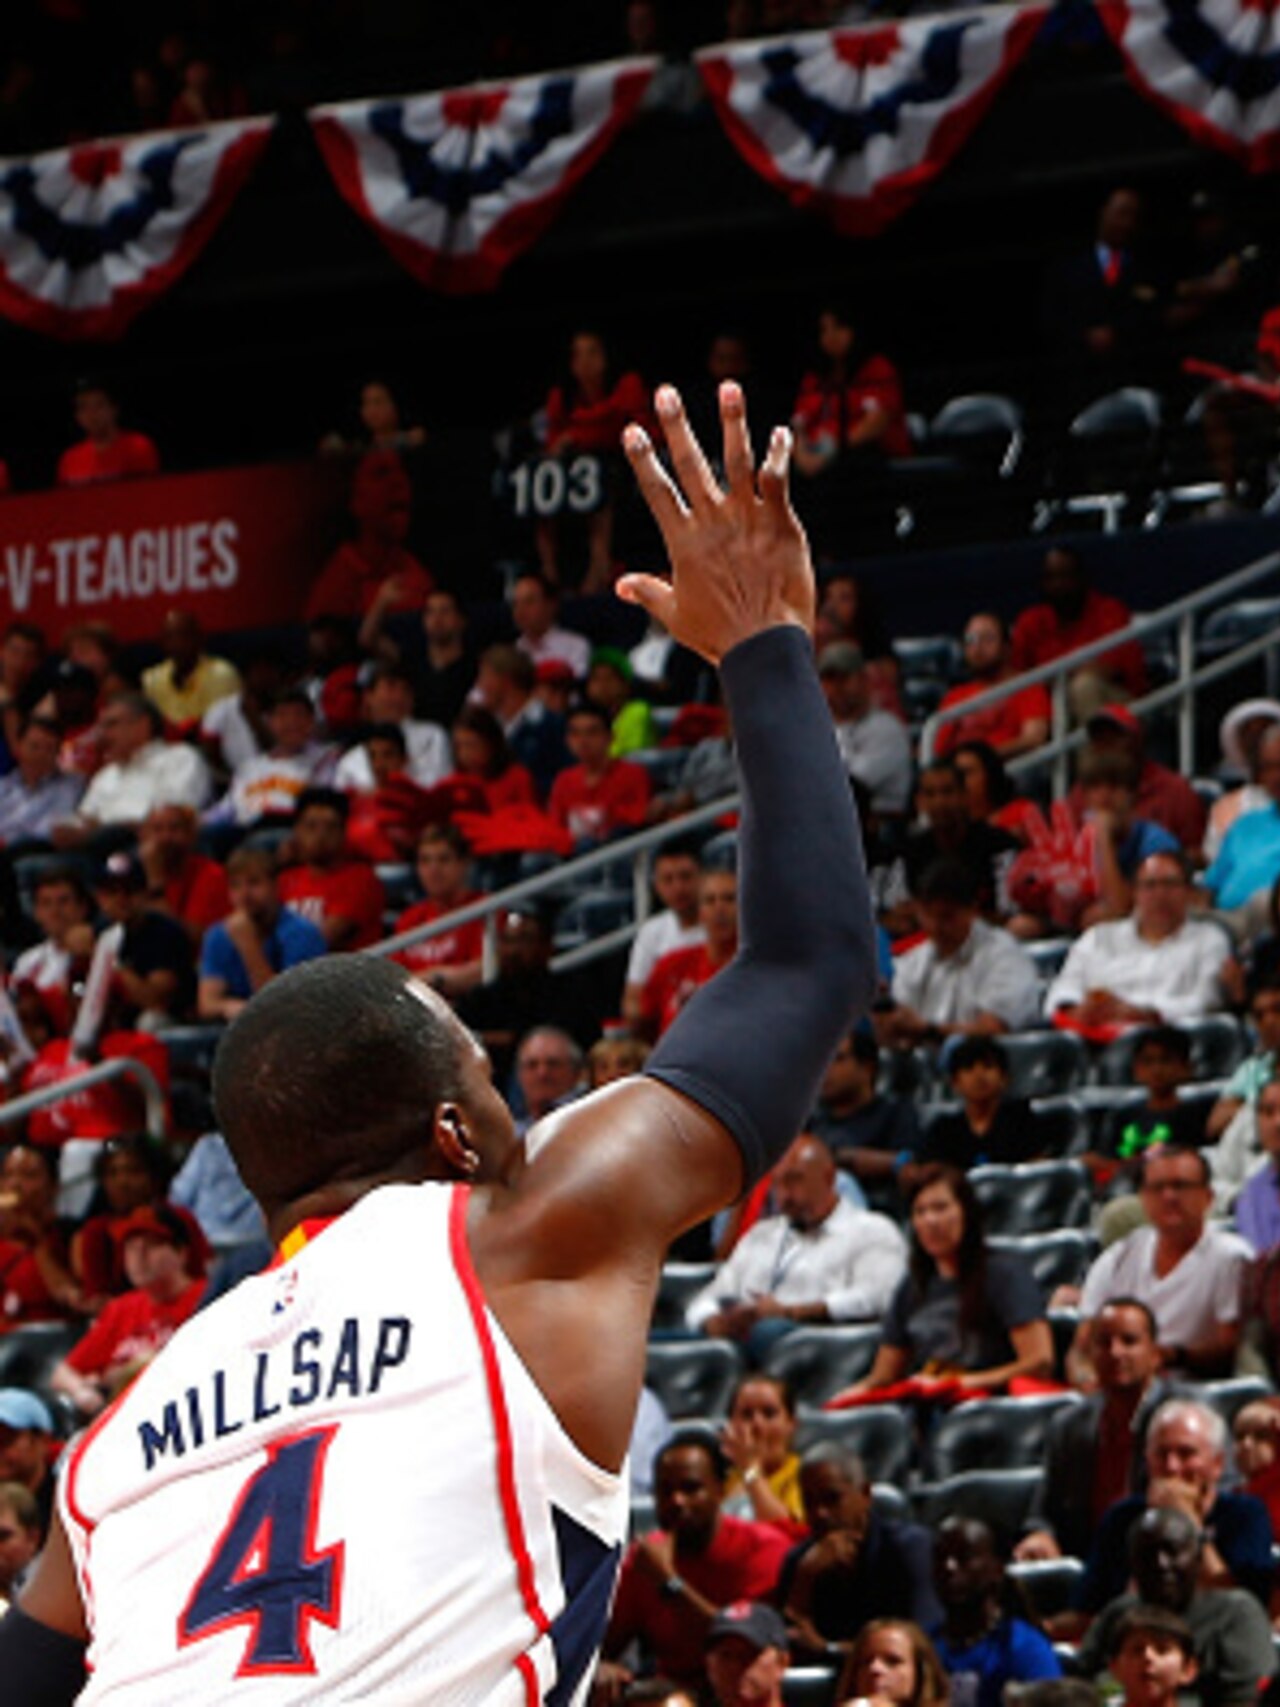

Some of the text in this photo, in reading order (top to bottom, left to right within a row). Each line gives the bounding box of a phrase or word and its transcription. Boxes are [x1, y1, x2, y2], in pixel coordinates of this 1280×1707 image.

[508, 456, 600, 515] 103
[138, 1316, 411, 1471] MILLSAP
[177, 1423, 345, 1680] 4
